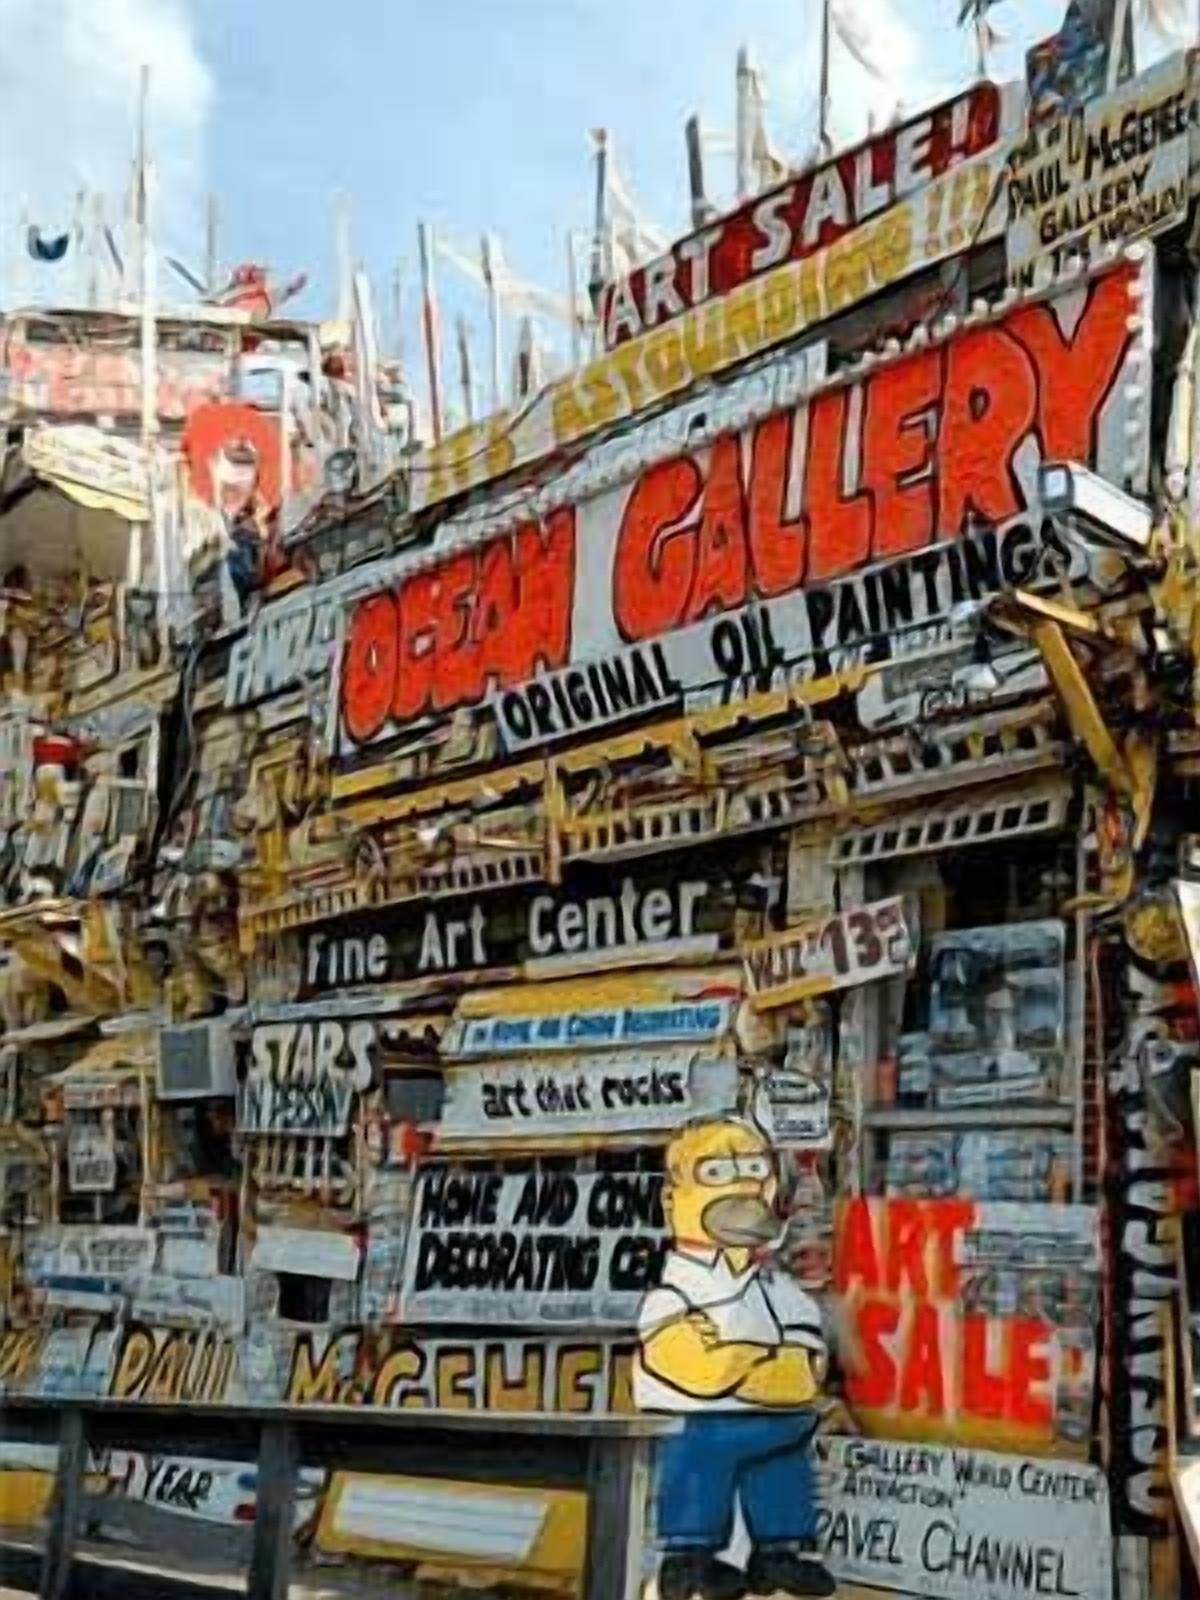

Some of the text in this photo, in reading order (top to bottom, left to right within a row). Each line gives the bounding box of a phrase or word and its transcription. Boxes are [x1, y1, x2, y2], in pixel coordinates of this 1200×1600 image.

[604, 230, 724, 347] ART
[341, 505, 576, 744] OCEAN
[612, 262, 1142, 644] GALLERY
[501, 643, 682, 740] ORIGINAL
[711, 605, 786, 692] OIL
[416, 912, 488, 970] Art
[528, 878, 708, 955] Center
[252, 1020, 376, 1092] STARS
[482, 1078, 532, 1118] art
[601, 1066, 685, 1108] rocks
[511, 1168, 581, 1228] AND
[832, 1195, 974, 1300] ART
[845, 1305, 1060, 1428] SALE
[816, 1506, 1092, 1598] RAVEL CHANNEL
